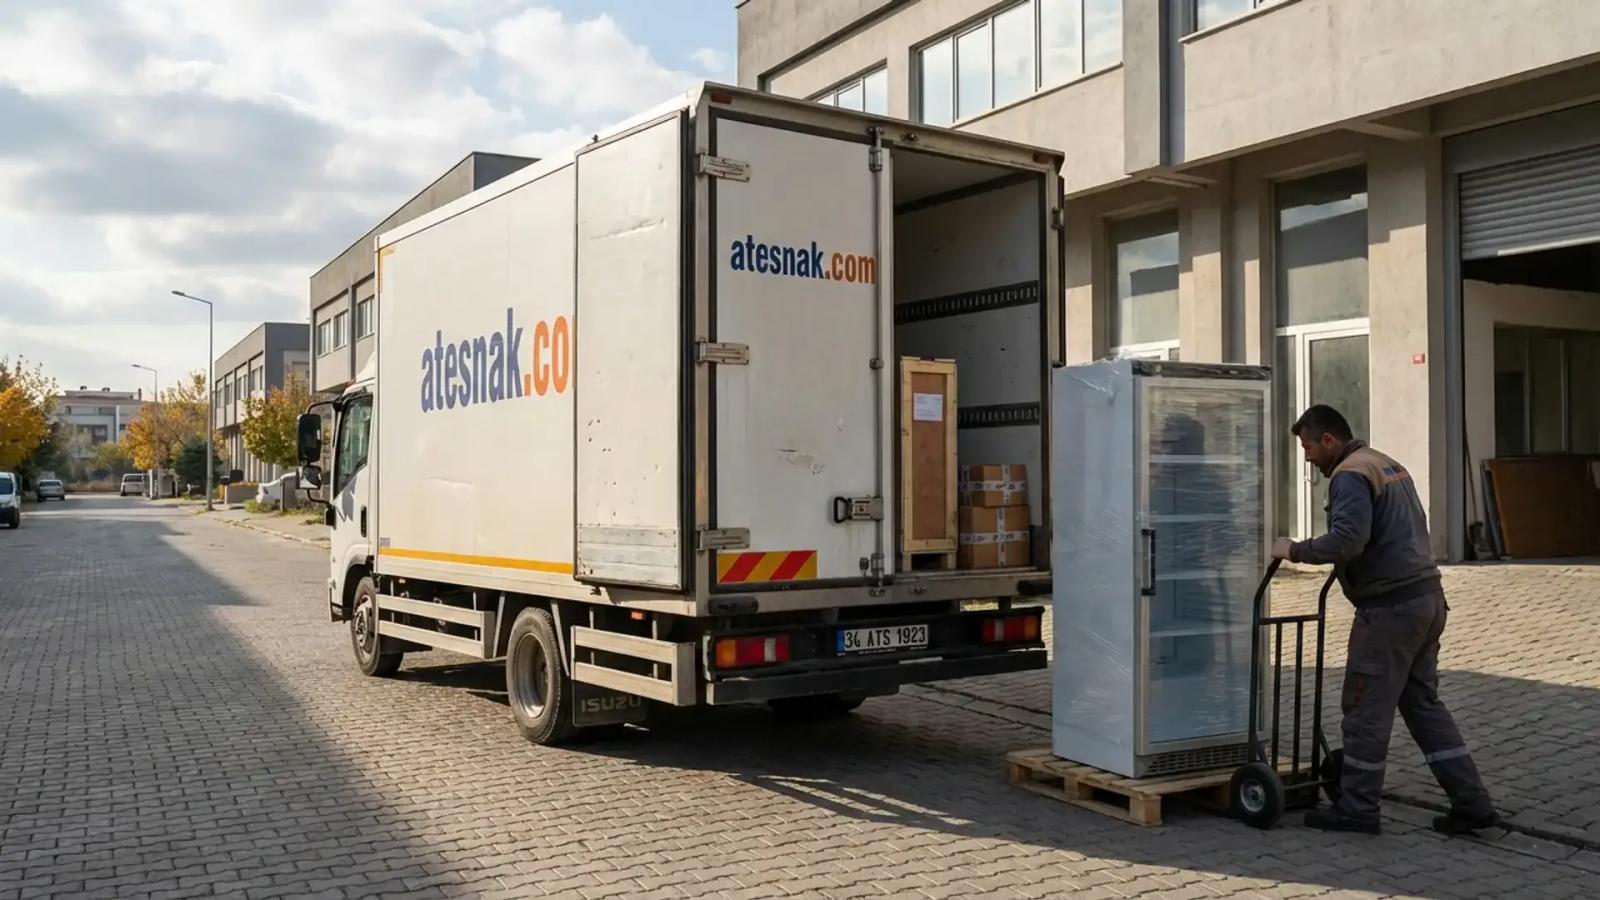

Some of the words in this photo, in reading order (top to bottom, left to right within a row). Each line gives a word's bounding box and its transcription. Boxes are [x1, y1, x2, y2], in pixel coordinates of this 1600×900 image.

[730, 234, 876, 285] atesnak.com
[421, 307, 575, 413] atesnak.co
[867, 629, 891, 647] ATS
[896, 626, 926, 645] 1923
[581, 695, 642, 713] ISUZU
